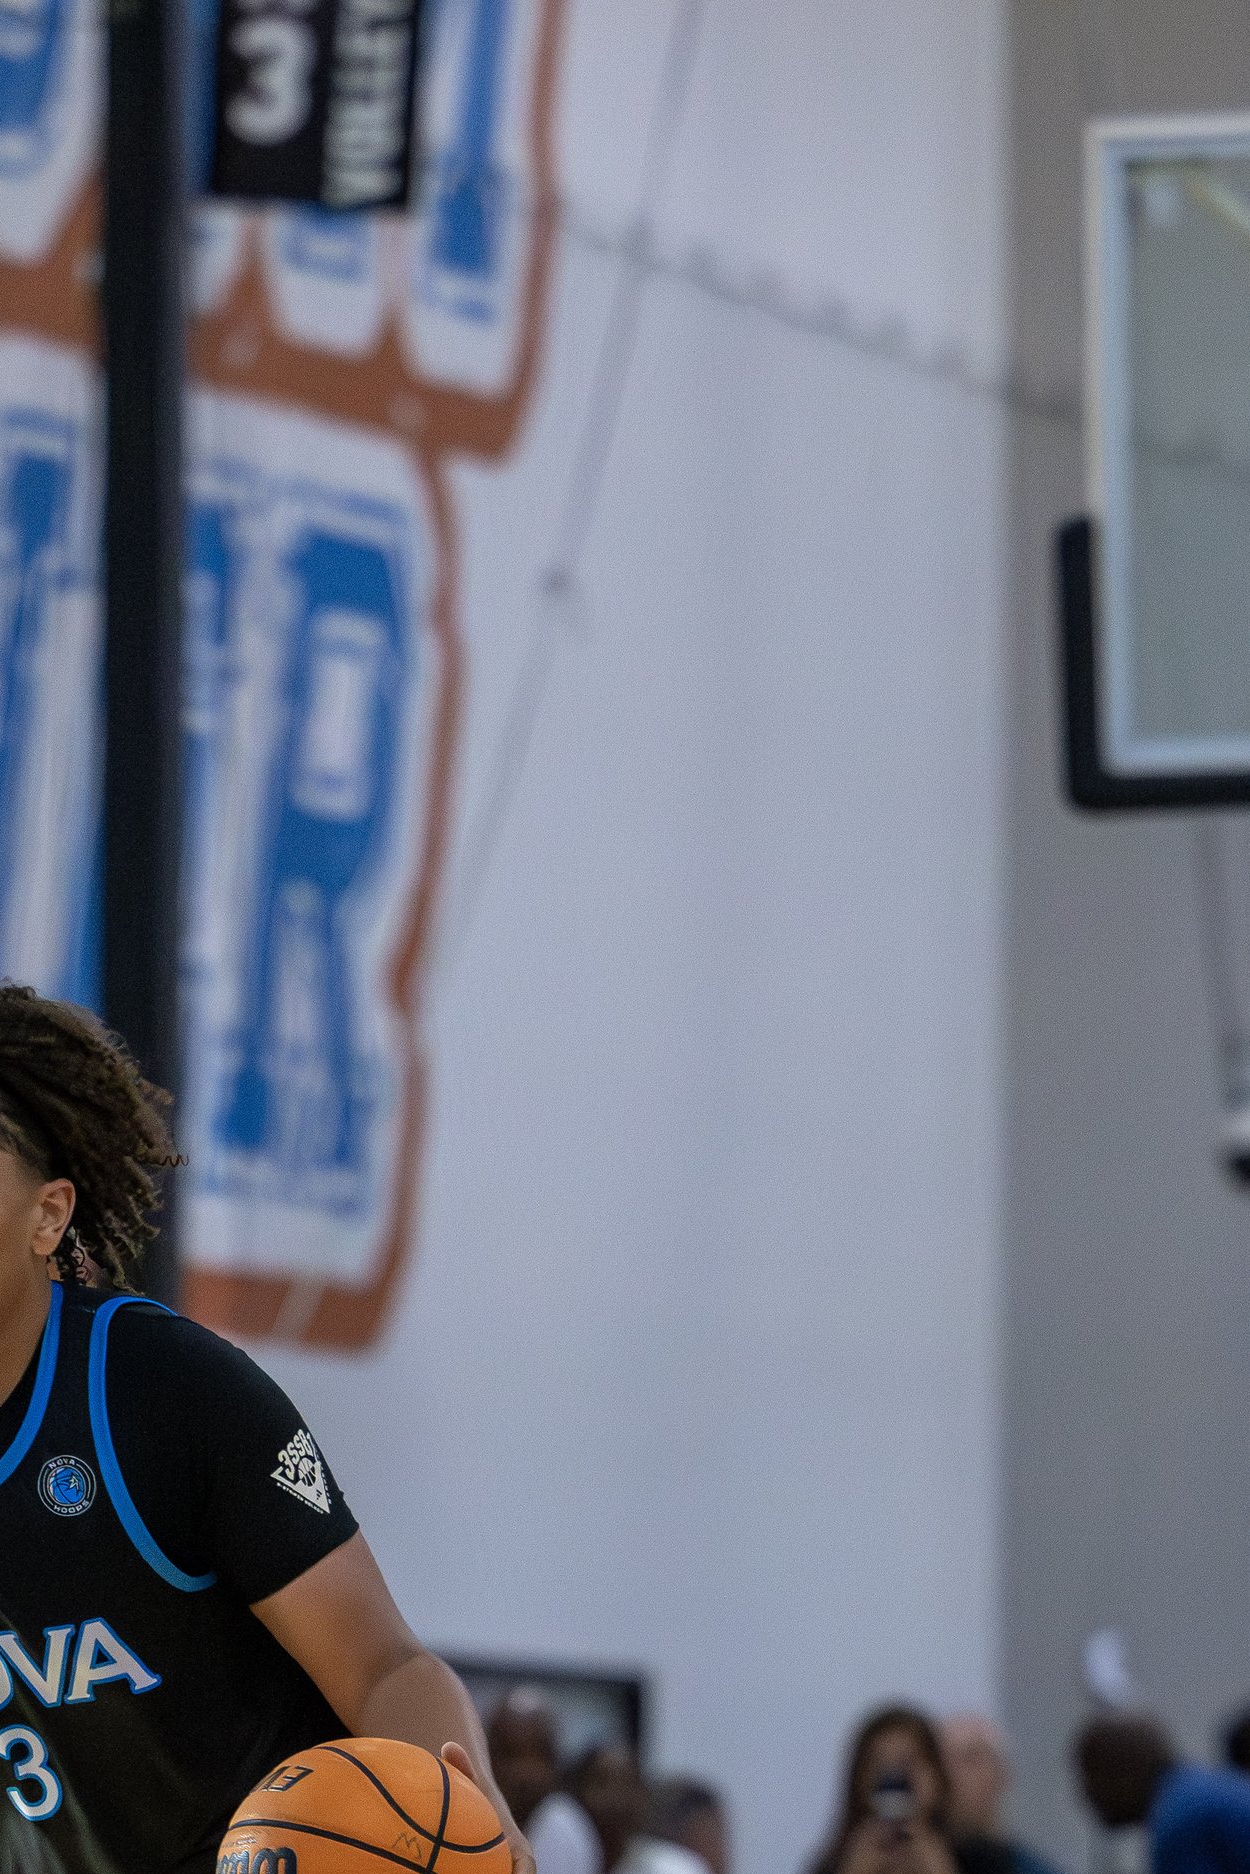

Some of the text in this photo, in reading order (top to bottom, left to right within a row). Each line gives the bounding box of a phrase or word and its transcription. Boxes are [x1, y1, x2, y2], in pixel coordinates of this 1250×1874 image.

[223, 14, 316, 147] 3
[48, 1458, 76, 1470] NOVA
[53, 1499, 90, 1514] HOOPS
